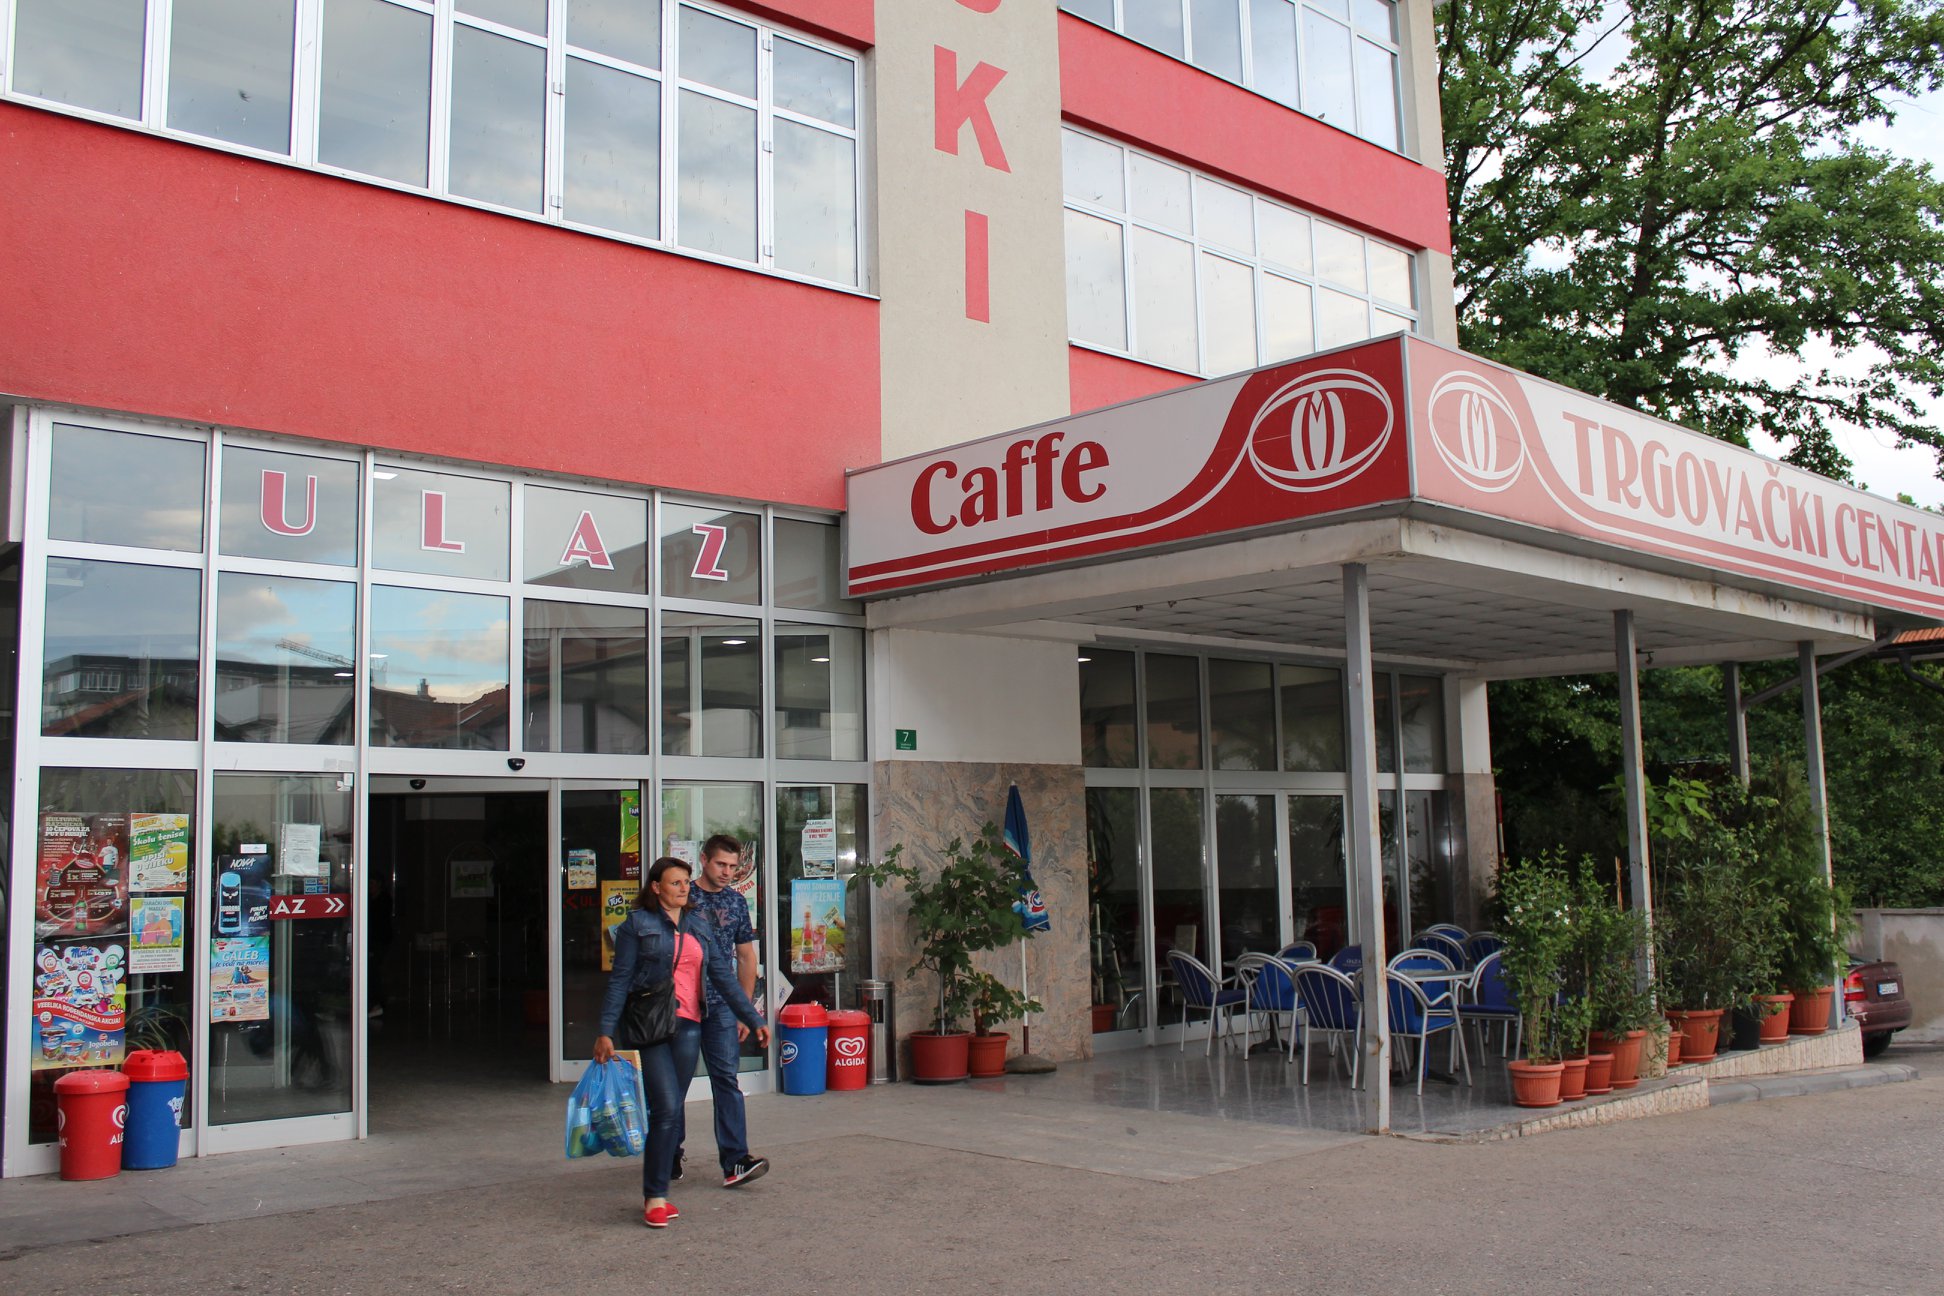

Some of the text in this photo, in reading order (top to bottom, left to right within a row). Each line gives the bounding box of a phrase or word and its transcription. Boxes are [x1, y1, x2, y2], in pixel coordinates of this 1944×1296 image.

[933, 0, 1012, 323] KI
[911, 432, 1109, 534] Caffe
[1562, 411, 1828, 558] TRGOVAČKI
[902, 731, 910, 742] 7
[158, 830, 185, 841] tenisa
[230, 857, 256, 868] NOVA
[270, 898, 306, 915] AZ
[222, 950, 259, 961] GALEB
[835, 1057, 866, 1067] ALGIDA
